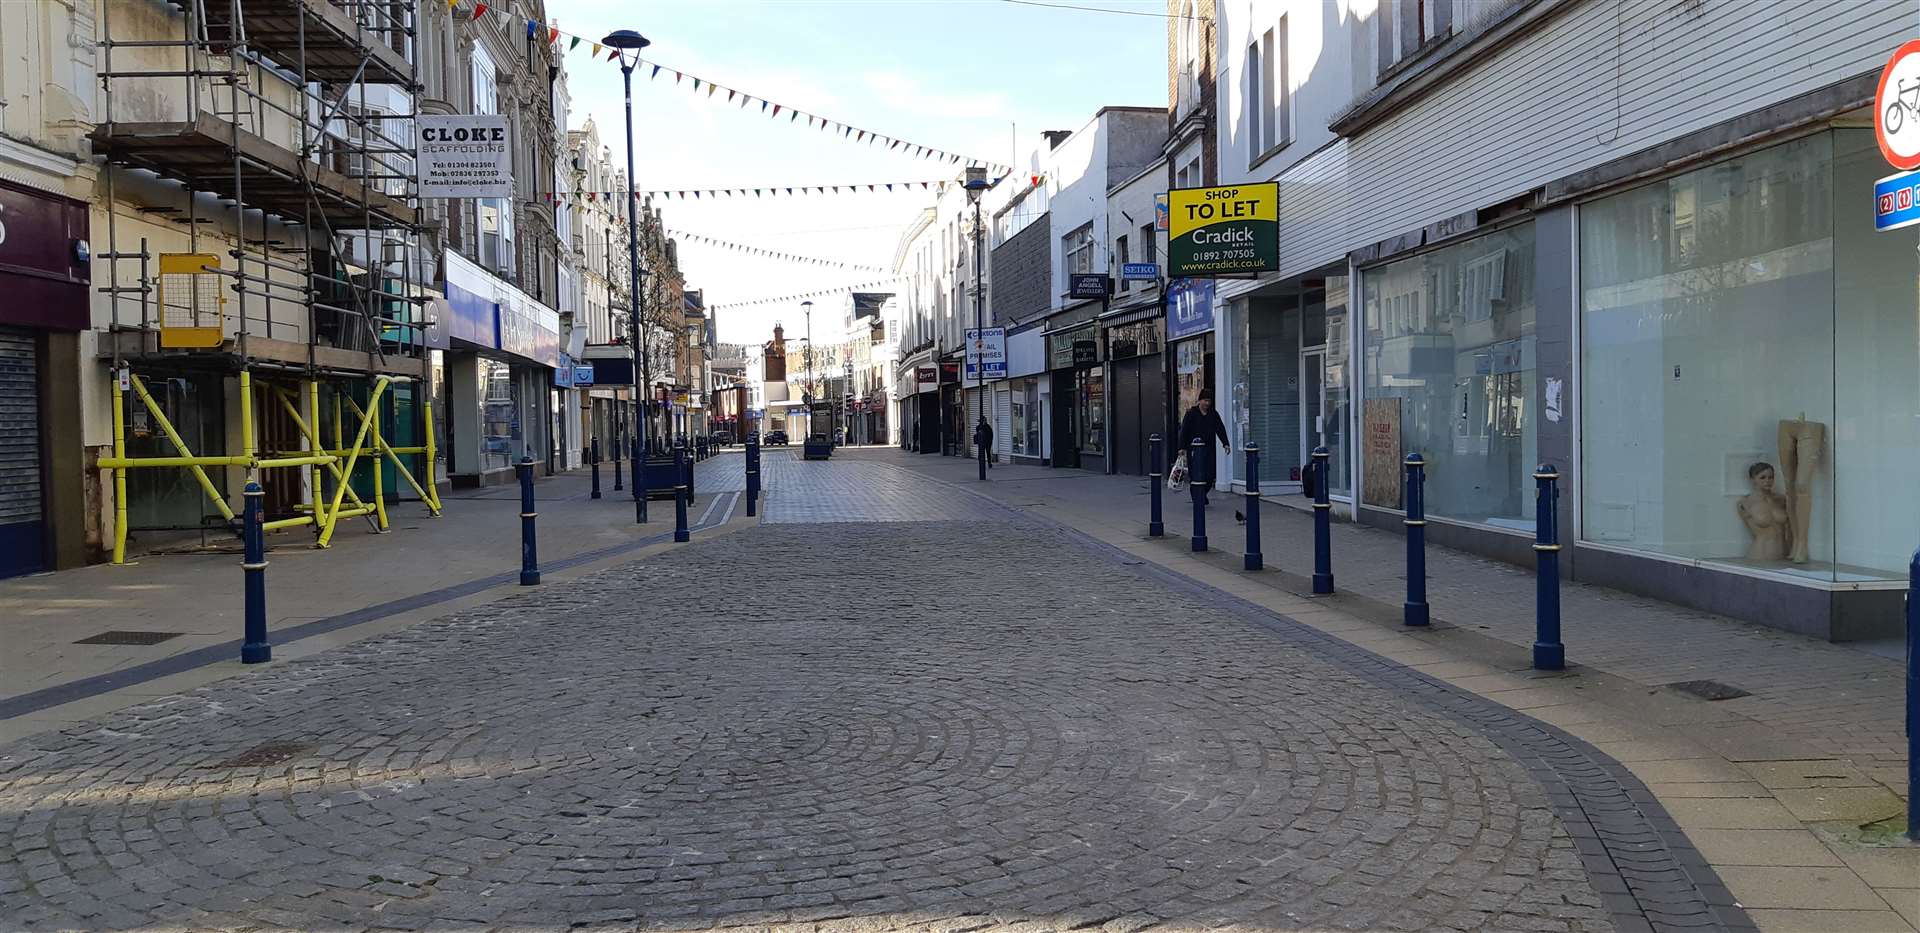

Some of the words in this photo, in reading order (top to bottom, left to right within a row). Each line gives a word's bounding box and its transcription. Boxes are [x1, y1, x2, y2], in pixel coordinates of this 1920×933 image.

[422, 128, 504, 141] CLOKE
[422, 145, 505, 153] SCAFFOLDING
[1205, 189, 1239, 200] SHOP
[1185, 203, 1214, 220] TO
[1221, 200, 1260, 218] LET
[1192, 227, 1254, 244] Cradick
[1193, 251, 1219, 261] 01892
[1223, 249, 1255, 259] 707505
[1124, 265, 1154, 274] SEIKO
[1181, 258, 1265, 270] www.cradick.co.uk
